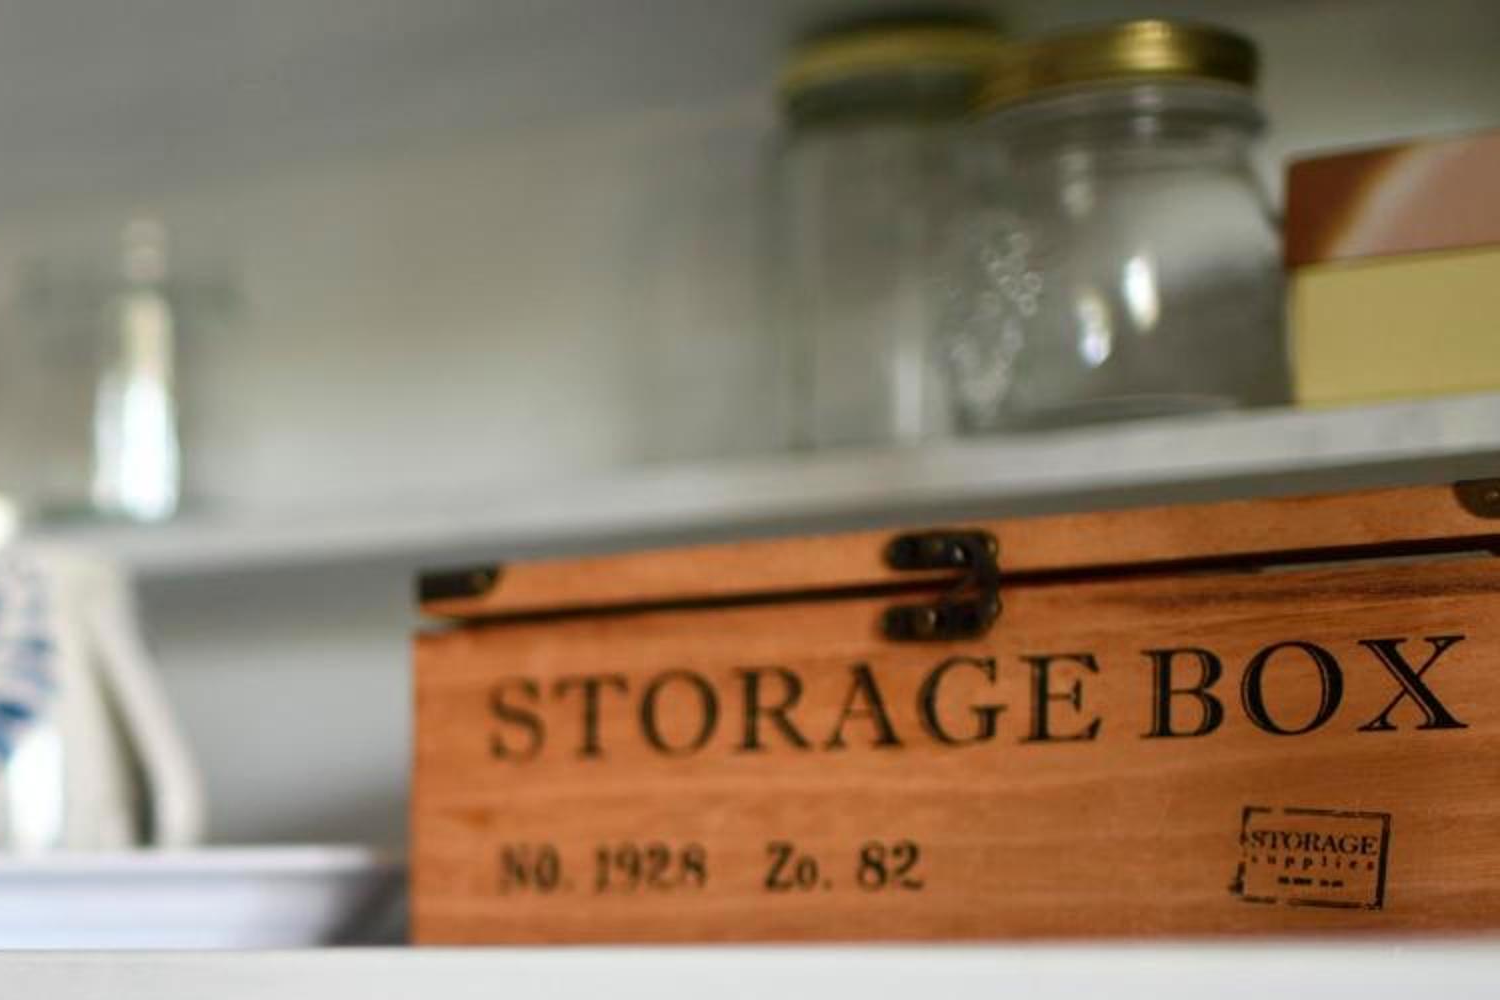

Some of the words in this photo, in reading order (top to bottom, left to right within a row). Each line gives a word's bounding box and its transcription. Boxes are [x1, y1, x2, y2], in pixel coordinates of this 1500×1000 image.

[488, 652, 1102, 764] STORAGE
[1139, 634, 1469, 740] BOX
[1251, 831, 1379, 856] STORAGE
[1251, 854, 1375, 871] supplies
[594, 841, 707, 893] 1928
[764, 841, 834, 890] Zo.
[856, 839, 924, 891] 82
